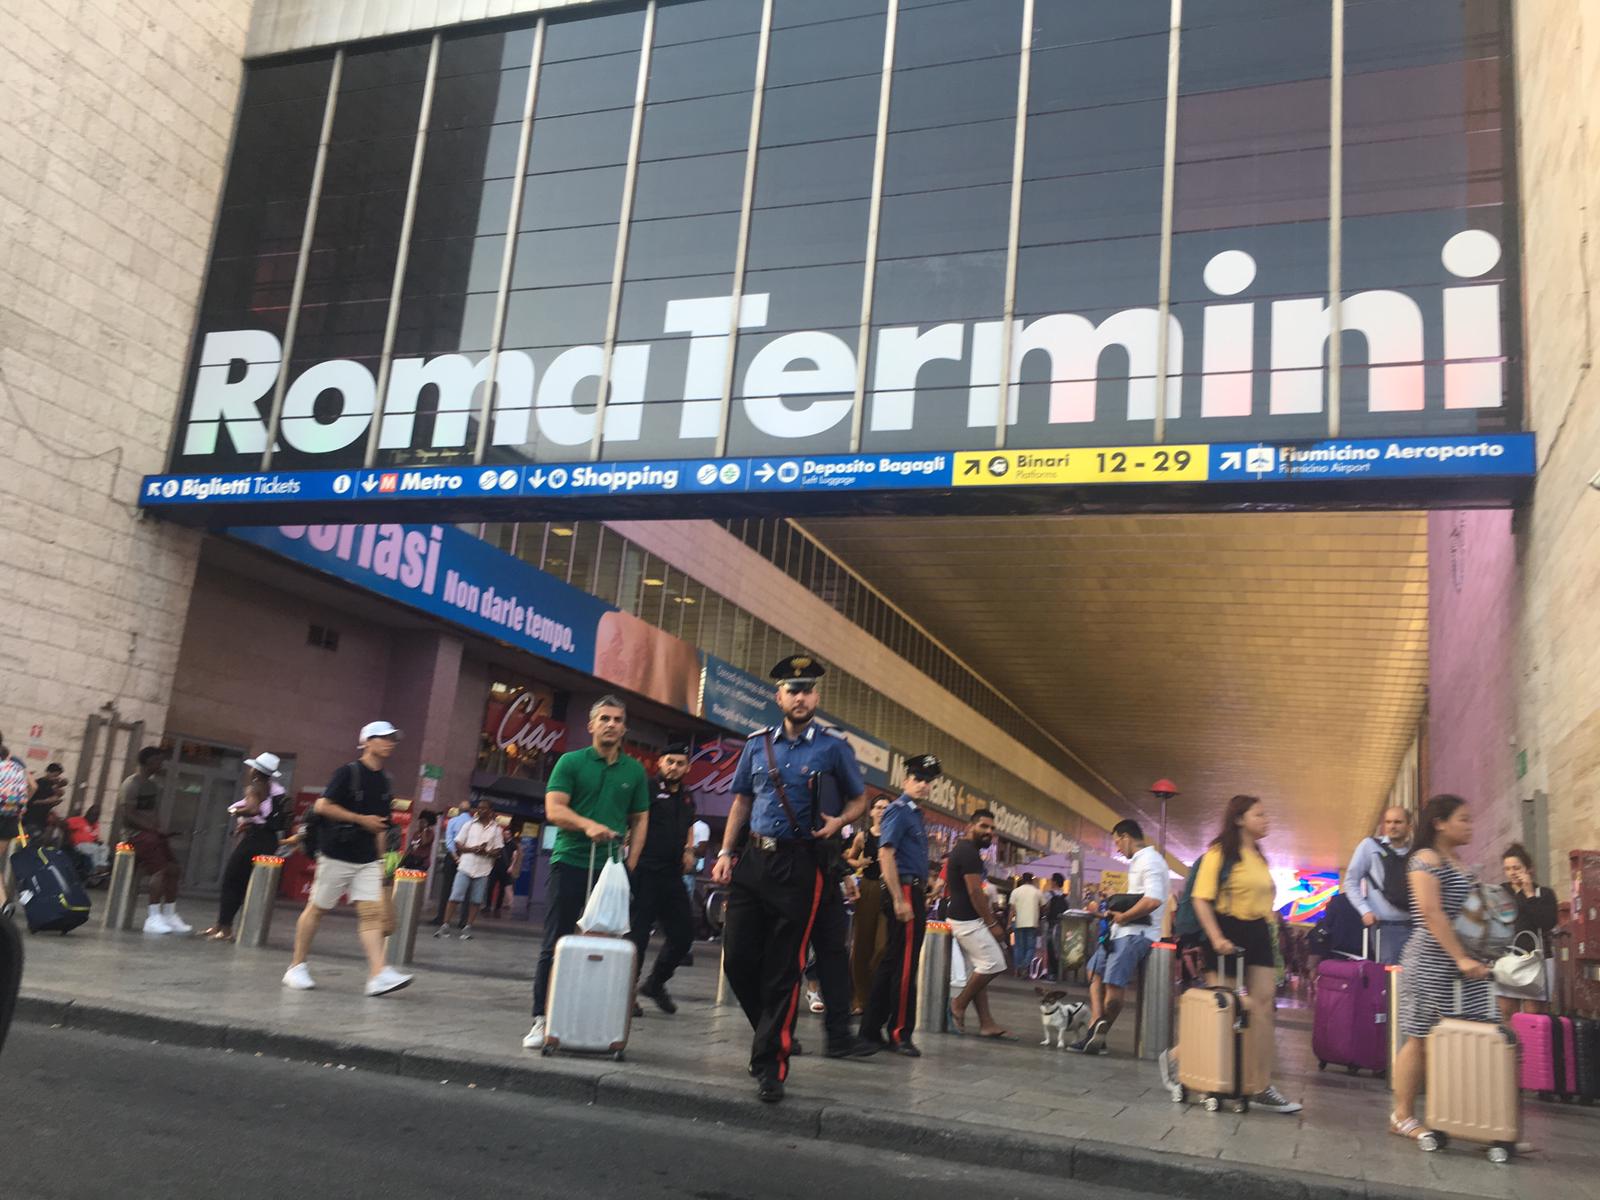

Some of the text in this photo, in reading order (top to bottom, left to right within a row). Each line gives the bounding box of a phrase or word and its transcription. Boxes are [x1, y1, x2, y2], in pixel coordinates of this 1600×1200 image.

[183, 229, 1503, 455] Roma Termini
[1017, 453, 1070, 468] Binari
[1279, 442, 1504, 462] Fiumicino Aeroporto
[571, 466, 679, 491] Shopping
[803, 456, 945, 476] Deposito Bagagli
[180, 475, 301, 500] Biglietti Tickets
[400, 472, 463, 491] Metro
[443, 569, 480, 613] Non
[480, 586, 525, 632] darle
[497, 691, 565, 753] Ciao
